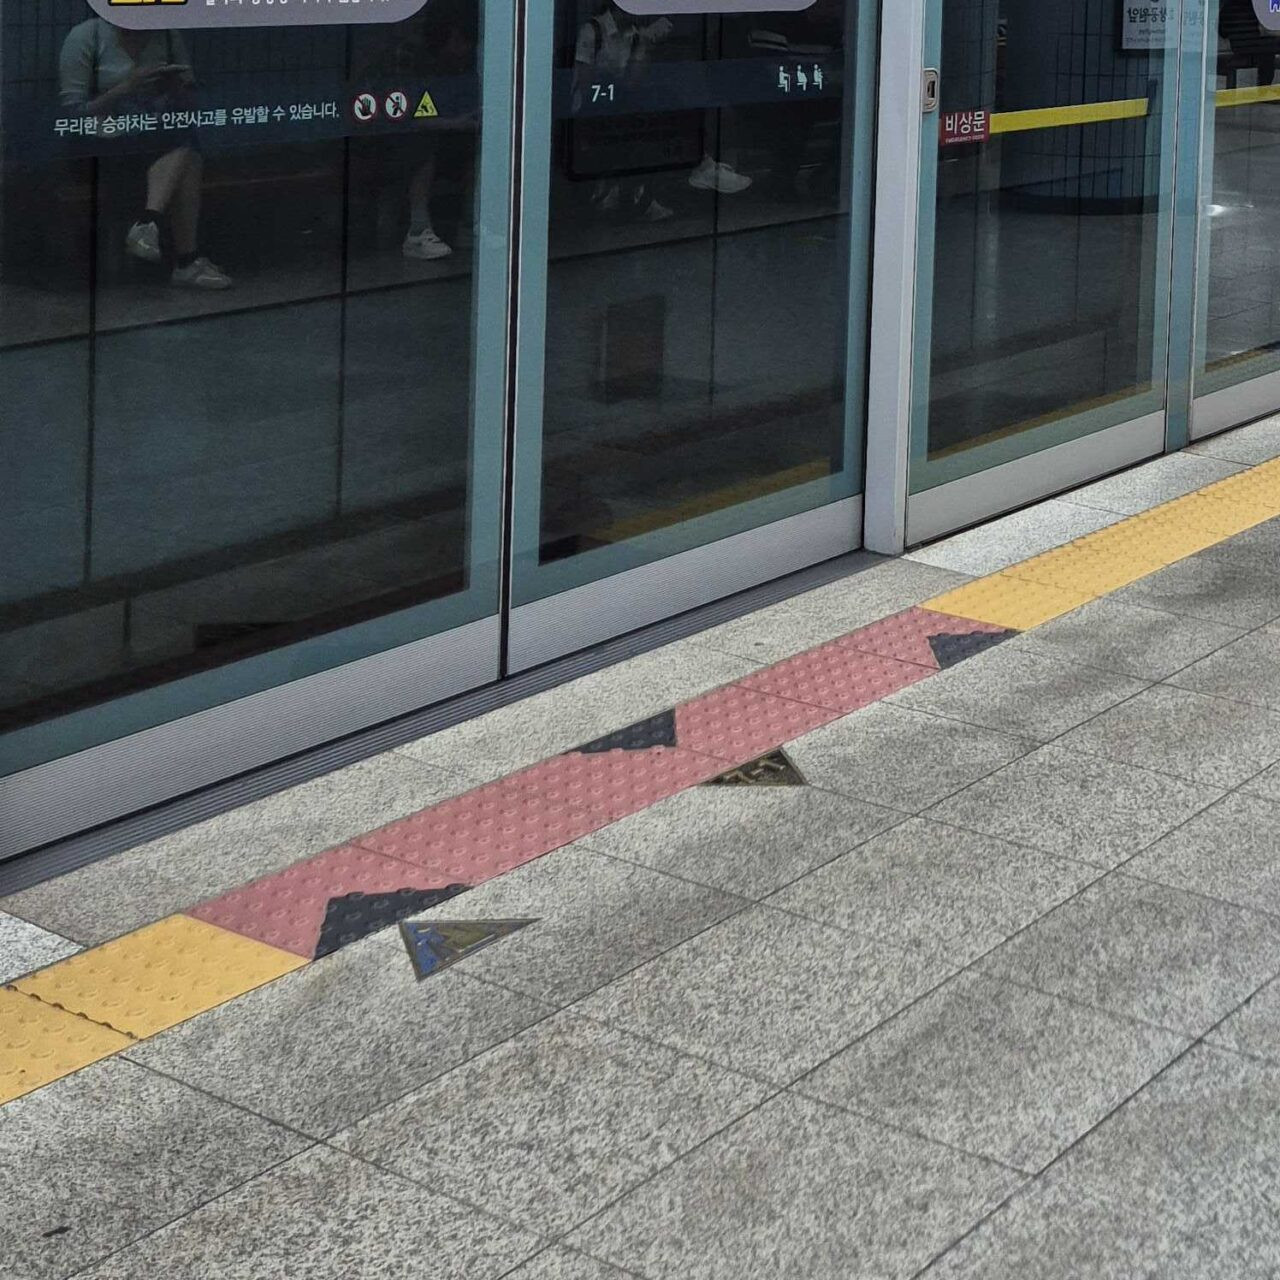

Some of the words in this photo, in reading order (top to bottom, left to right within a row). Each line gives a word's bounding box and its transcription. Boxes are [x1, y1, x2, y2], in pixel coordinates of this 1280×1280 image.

[591, 84, 615, 102] 7-1
[54, 117, 98, 136] 무리한
[102, 114, 158, 134] 승하차는
[161, 108, 226, 129] 안전사고를
[231, 105, 269, 124] 유발할
[272, 106, 286, 122] 수
[290, 101, 340, 120] 있습니다.
[945, 110, 986, 135] 비상문
